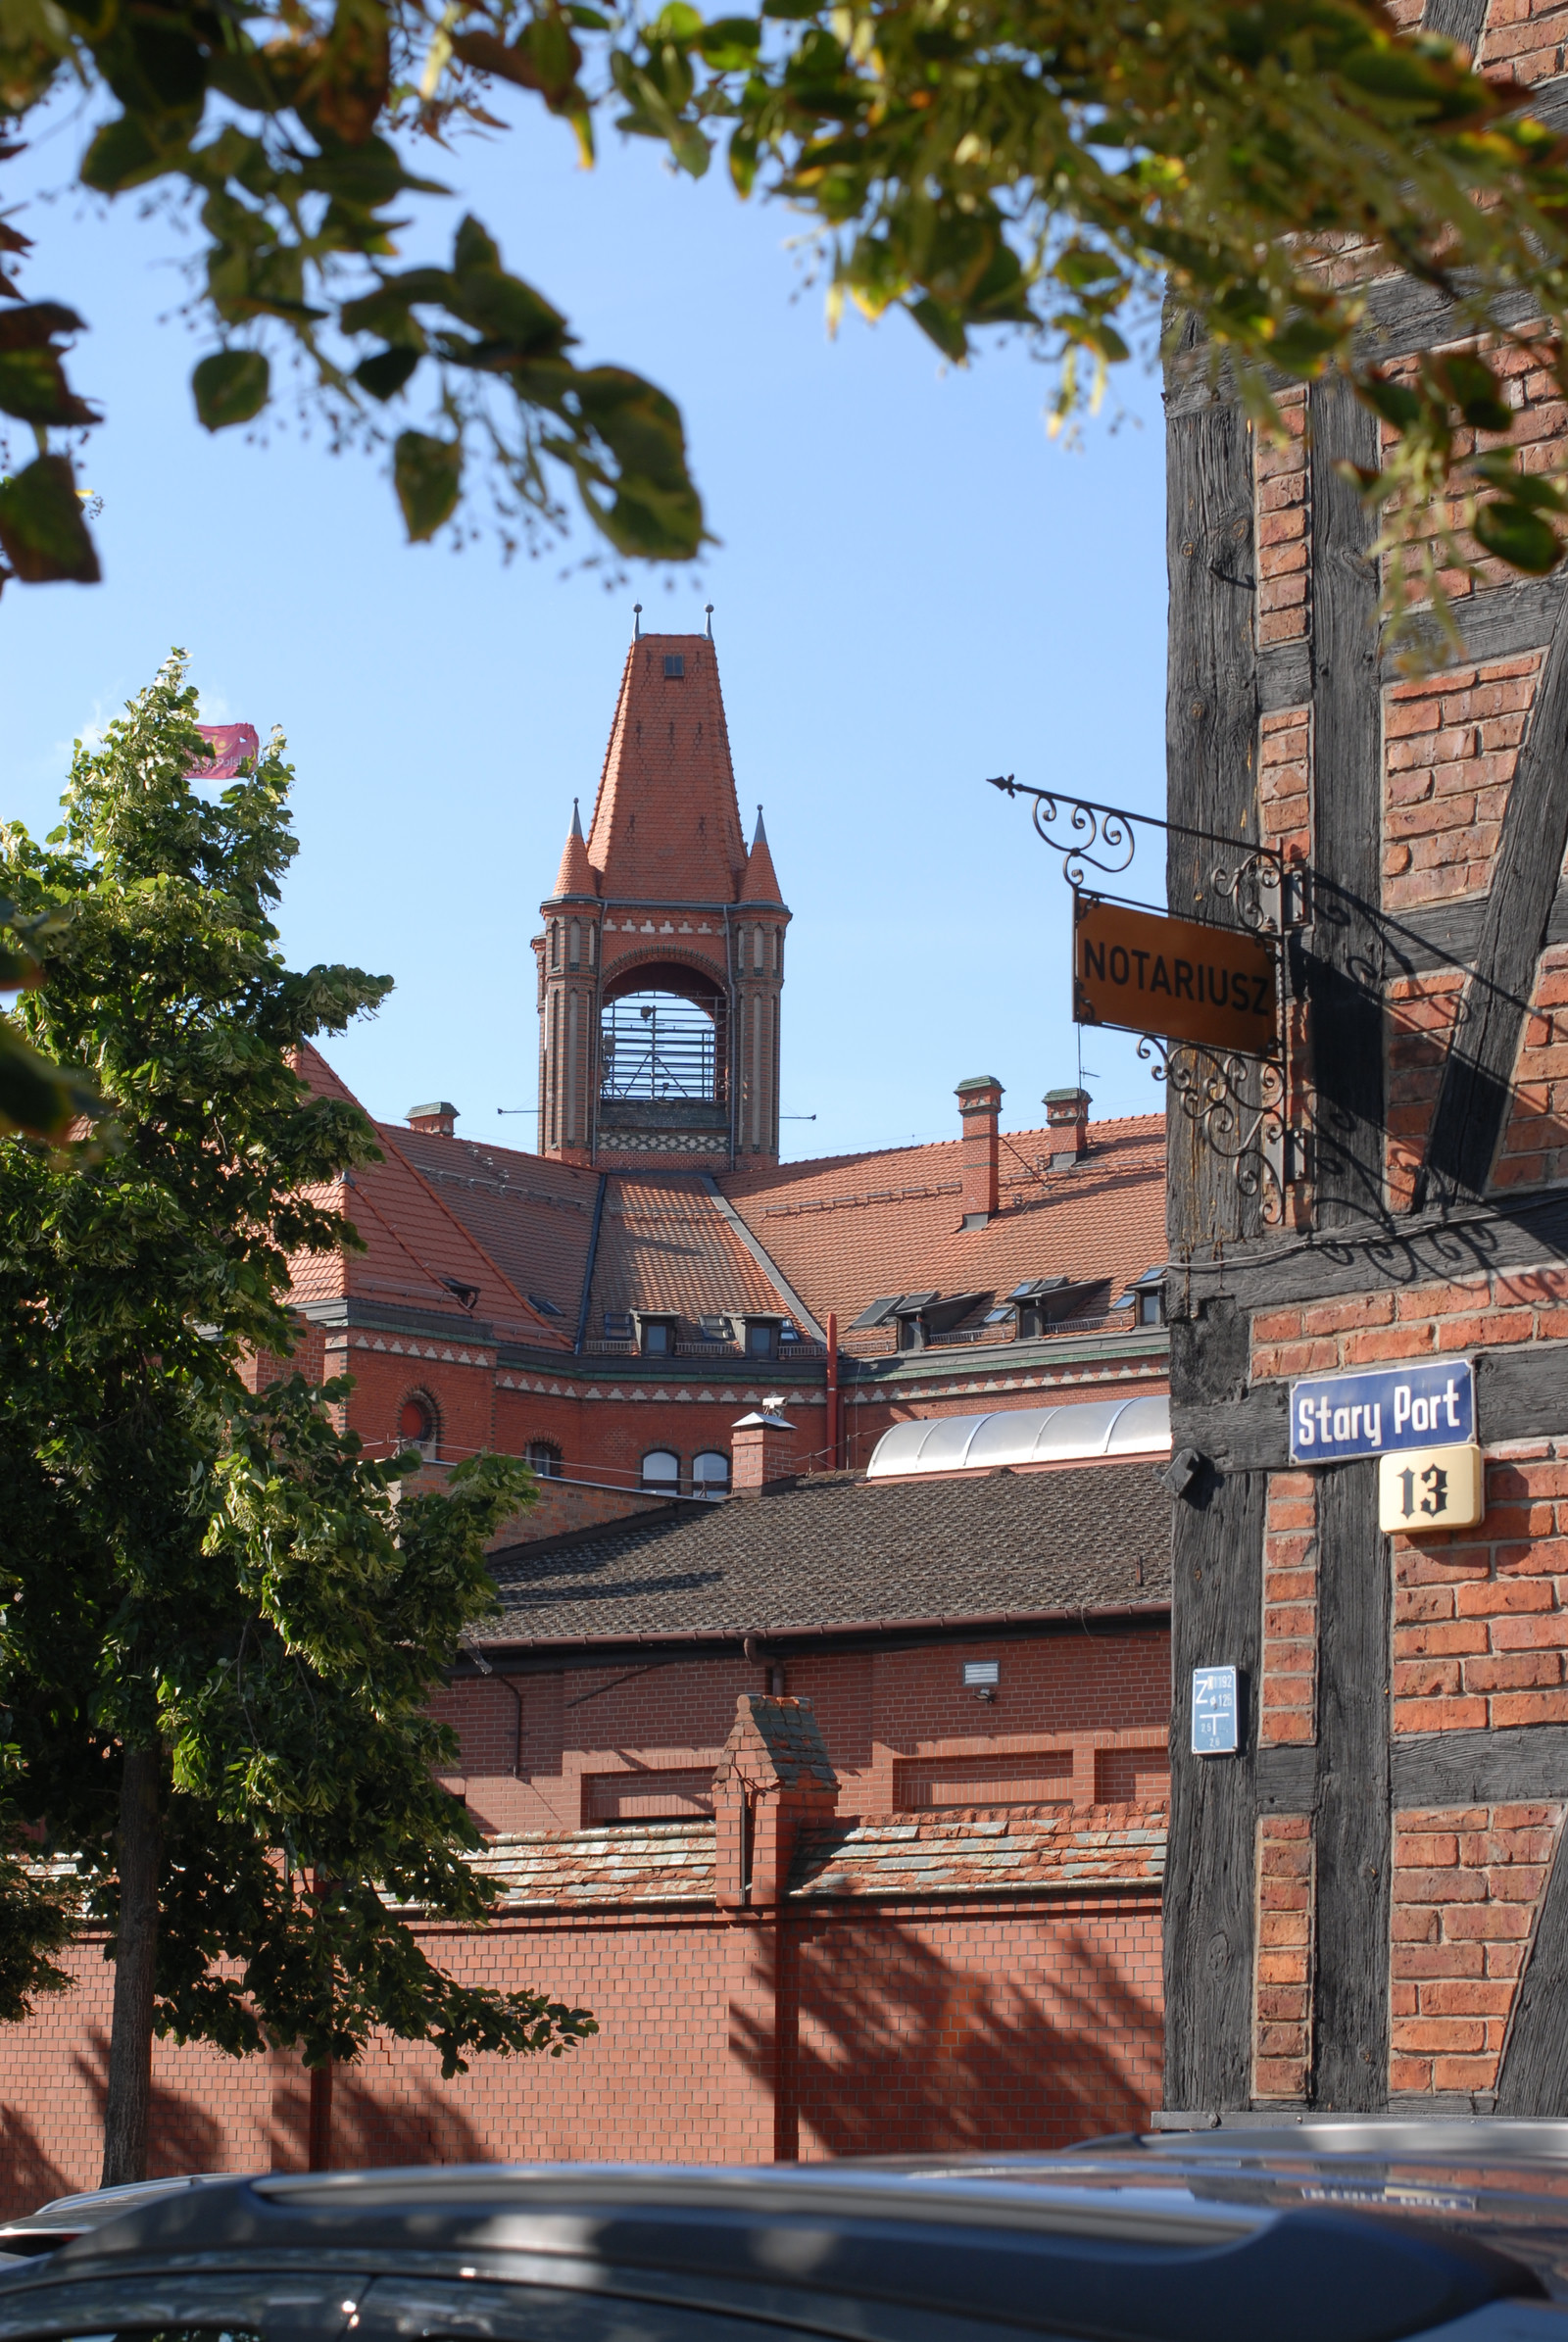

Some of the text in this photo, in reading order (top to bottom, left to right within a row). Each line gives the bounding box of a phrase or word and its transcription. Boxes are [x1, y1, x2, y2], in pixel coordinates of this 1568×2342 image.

[1084, 939, 1269, 1016] NOTARIUSZ
[1298, 1379, 1460, 1446] Stary Port
[1396, 1463, 1448, 1520] 13
[1196, 1680, 1208, 1704] Z
